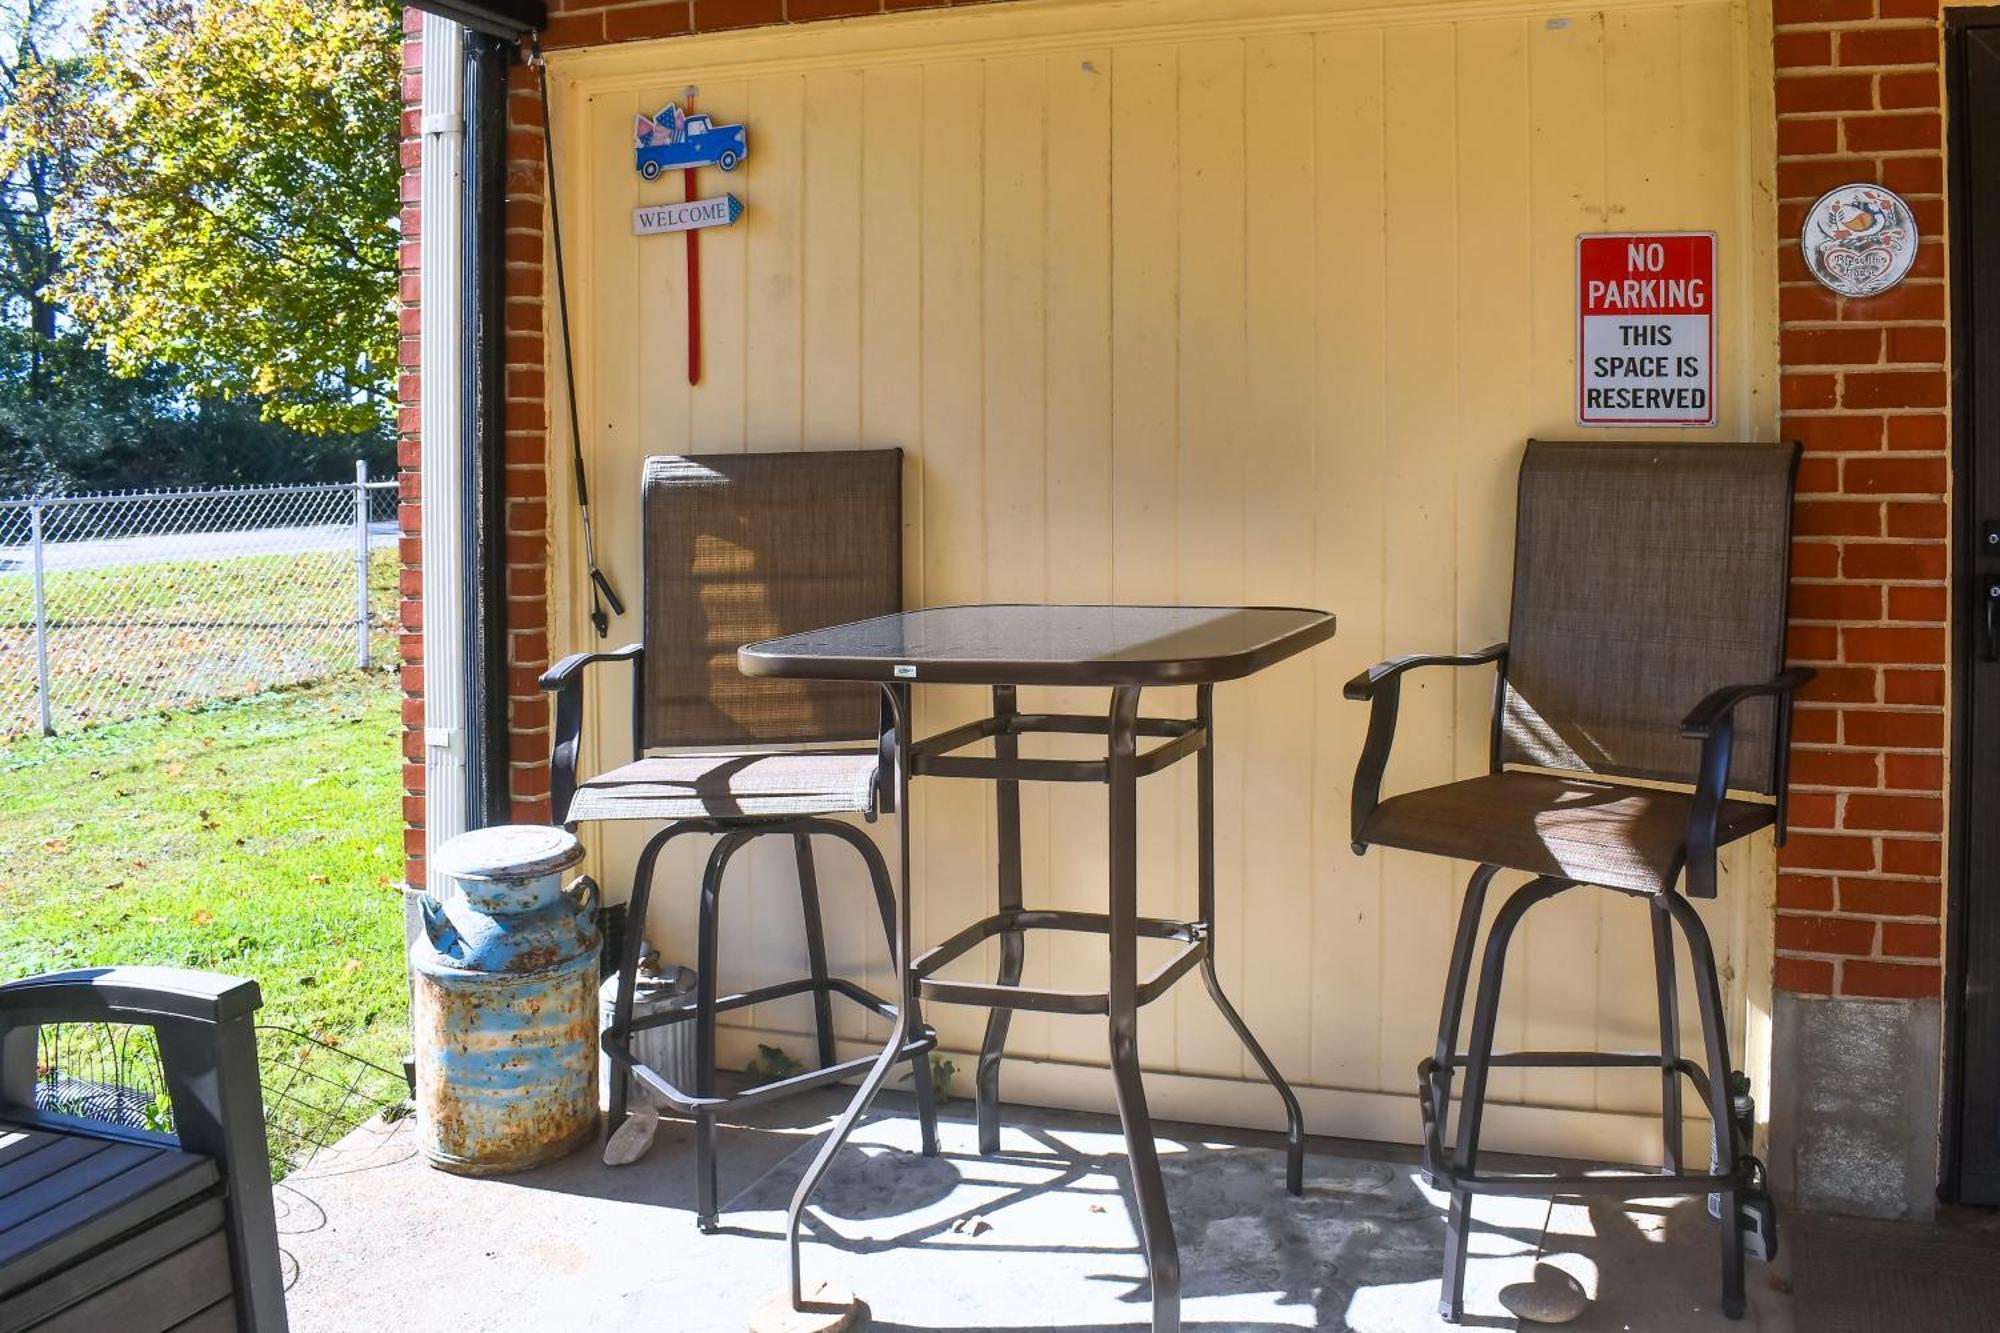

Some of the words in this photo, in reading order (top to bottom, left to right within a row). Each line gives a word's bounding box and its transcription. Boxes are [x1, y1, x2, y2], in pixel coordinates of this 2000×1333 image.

[640, 203, 726, 228] WELCOME
[1627, 243, 1665, 272] NO
[1588, 279, 1704, 309] PARKING
[1619, 325, 1672, 346] THIS
[1594, 356, 1668, 378] SPACE
[1677, 356, 1699, 377] IS
[1587, 388, 1706, 409] RESERVED
